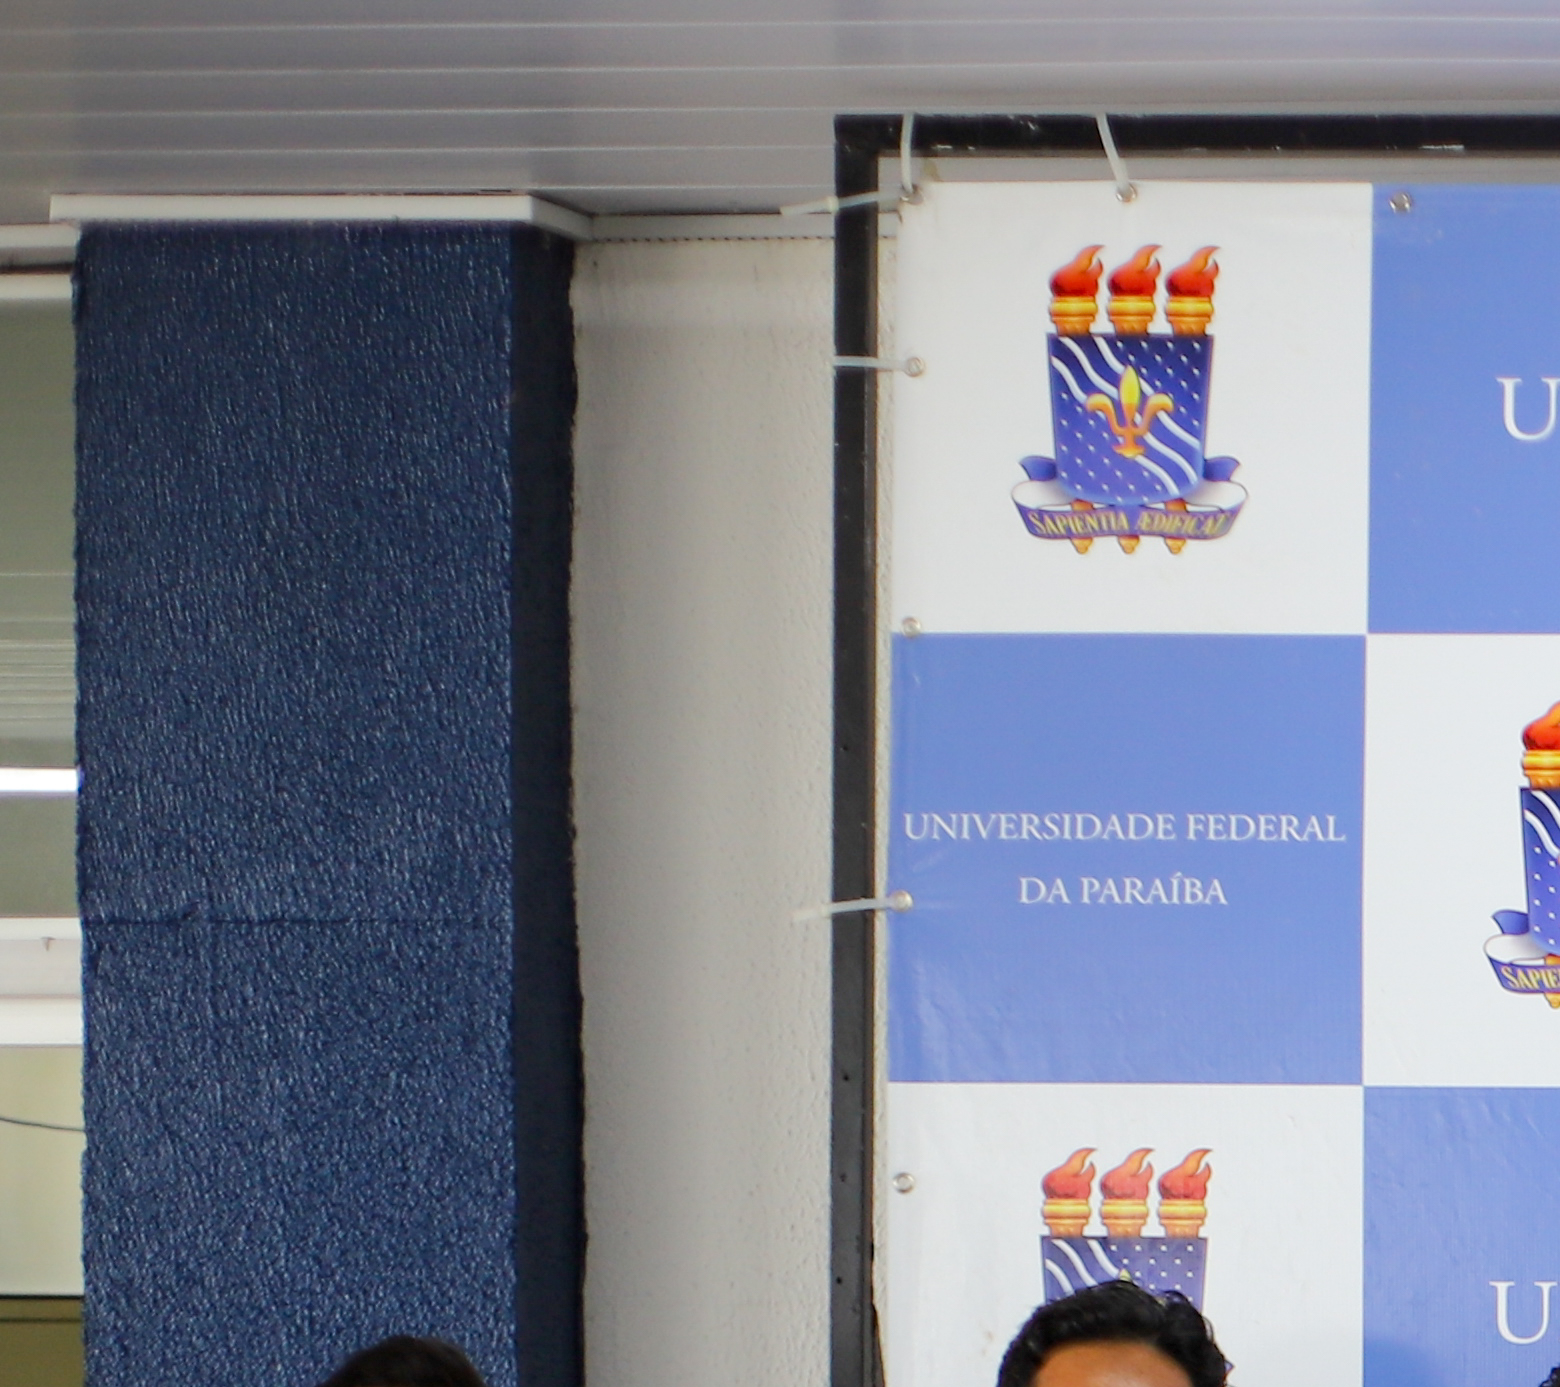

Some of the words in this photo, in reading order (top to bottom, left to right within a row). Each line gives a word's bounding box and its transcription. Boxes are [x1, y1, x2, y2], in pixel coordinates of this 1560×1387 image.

[1028, 510, 1129, 534] SAPIENTIA
[903, 812, 1176, 841] UNIVERSIDADE
[1186, 813, 1347, 842] FEDERAL
[1018, 876, 1071, 905] DA
[1080, 871, 1229, 905] PARAÍBA
